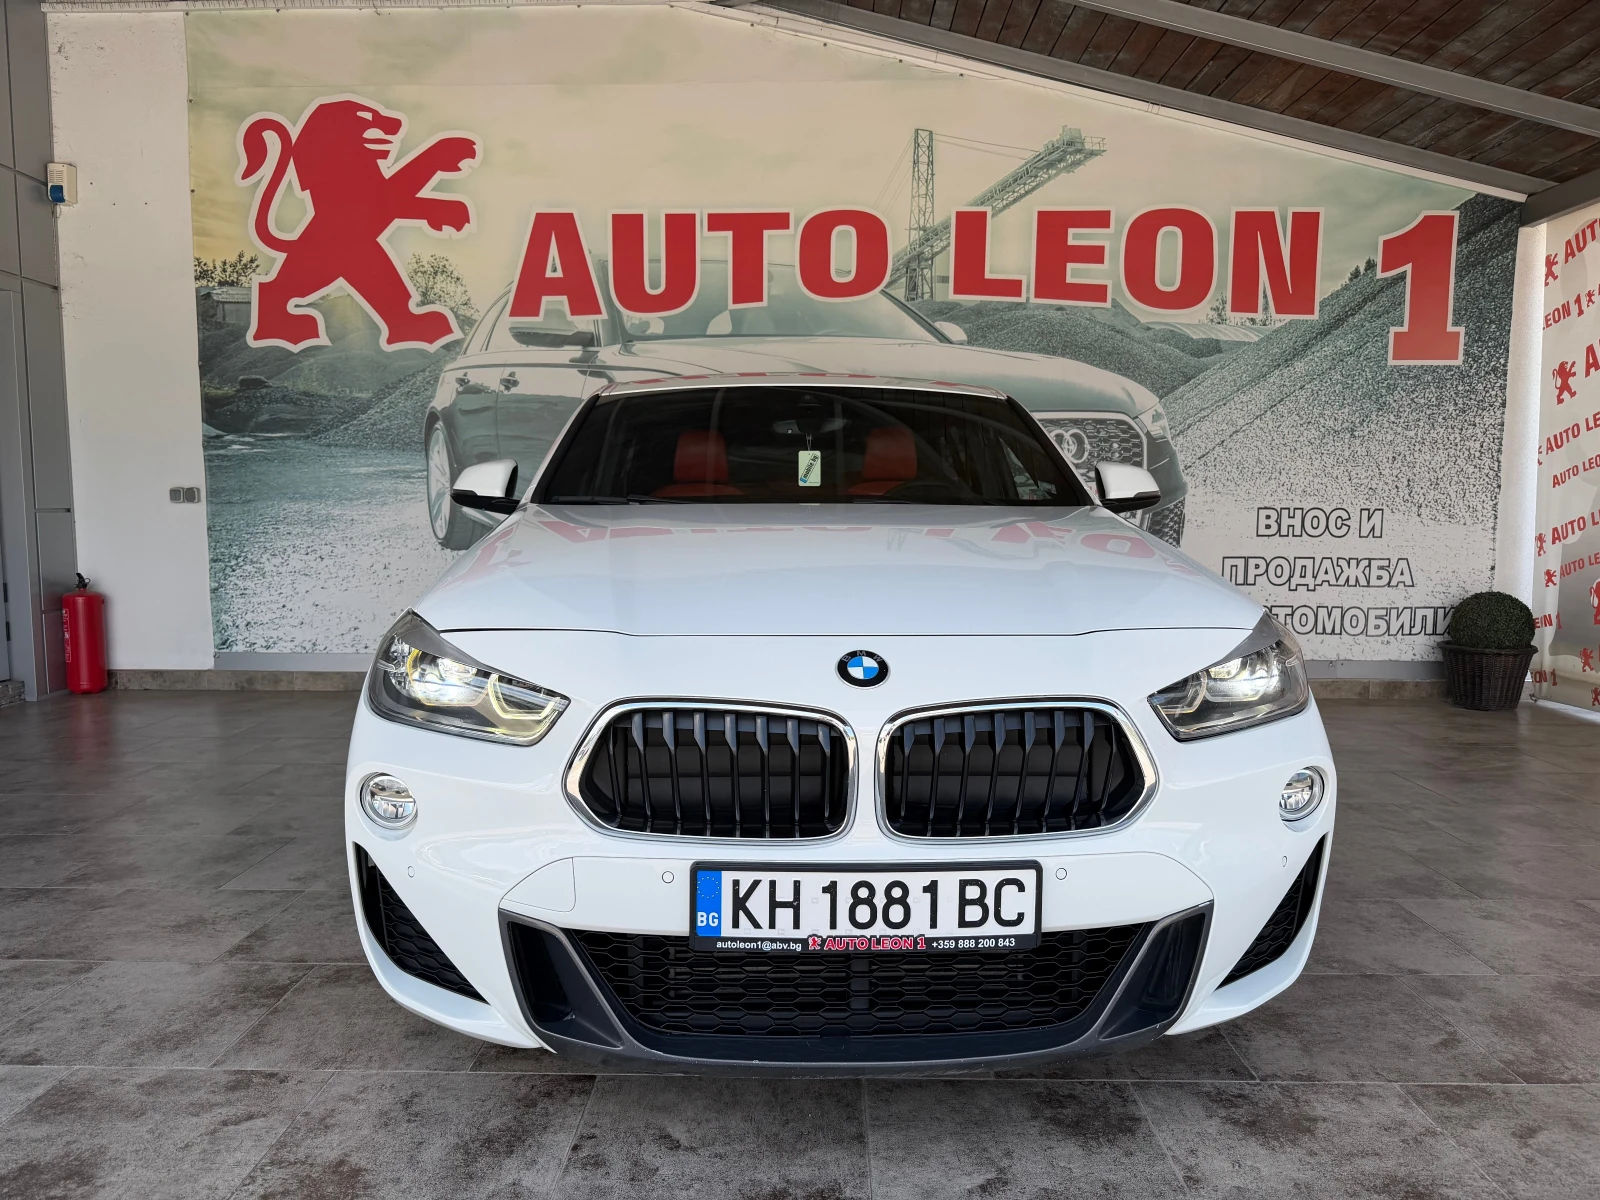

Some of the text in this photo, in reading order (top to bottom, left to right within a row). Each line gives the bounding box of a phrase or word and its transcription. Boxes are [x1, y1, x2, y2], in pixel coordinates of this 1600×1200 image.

[1564, 218, 1600, 264] AUT
[506, 207, 1464, 363] AUTO LEON 1
[1543, 293, 1584, 330] EON 1
[1546, 423, 1580, 455] AUTO
[1552, 465, 1579, 488] AUTO
[1256, 507, 1384, 538] ВНОС И
[1552, 516, 1586, 545] AUTO
[1222, 556, 1415, 591] ПРОДАЖБА
[1560, 558, 1585, 579] AUTO
[841, 650, 883, 662] BMW
[731, 877, 1026, 930] KH 1881 BC
[697, 911, 719, 927] BG
[716, 940, 802, 951] autoleon1@abv.bg
[824, 936, 926, 950] AUTO LEON 1
[932, 938, 1015, 949] +359 888 200 843
